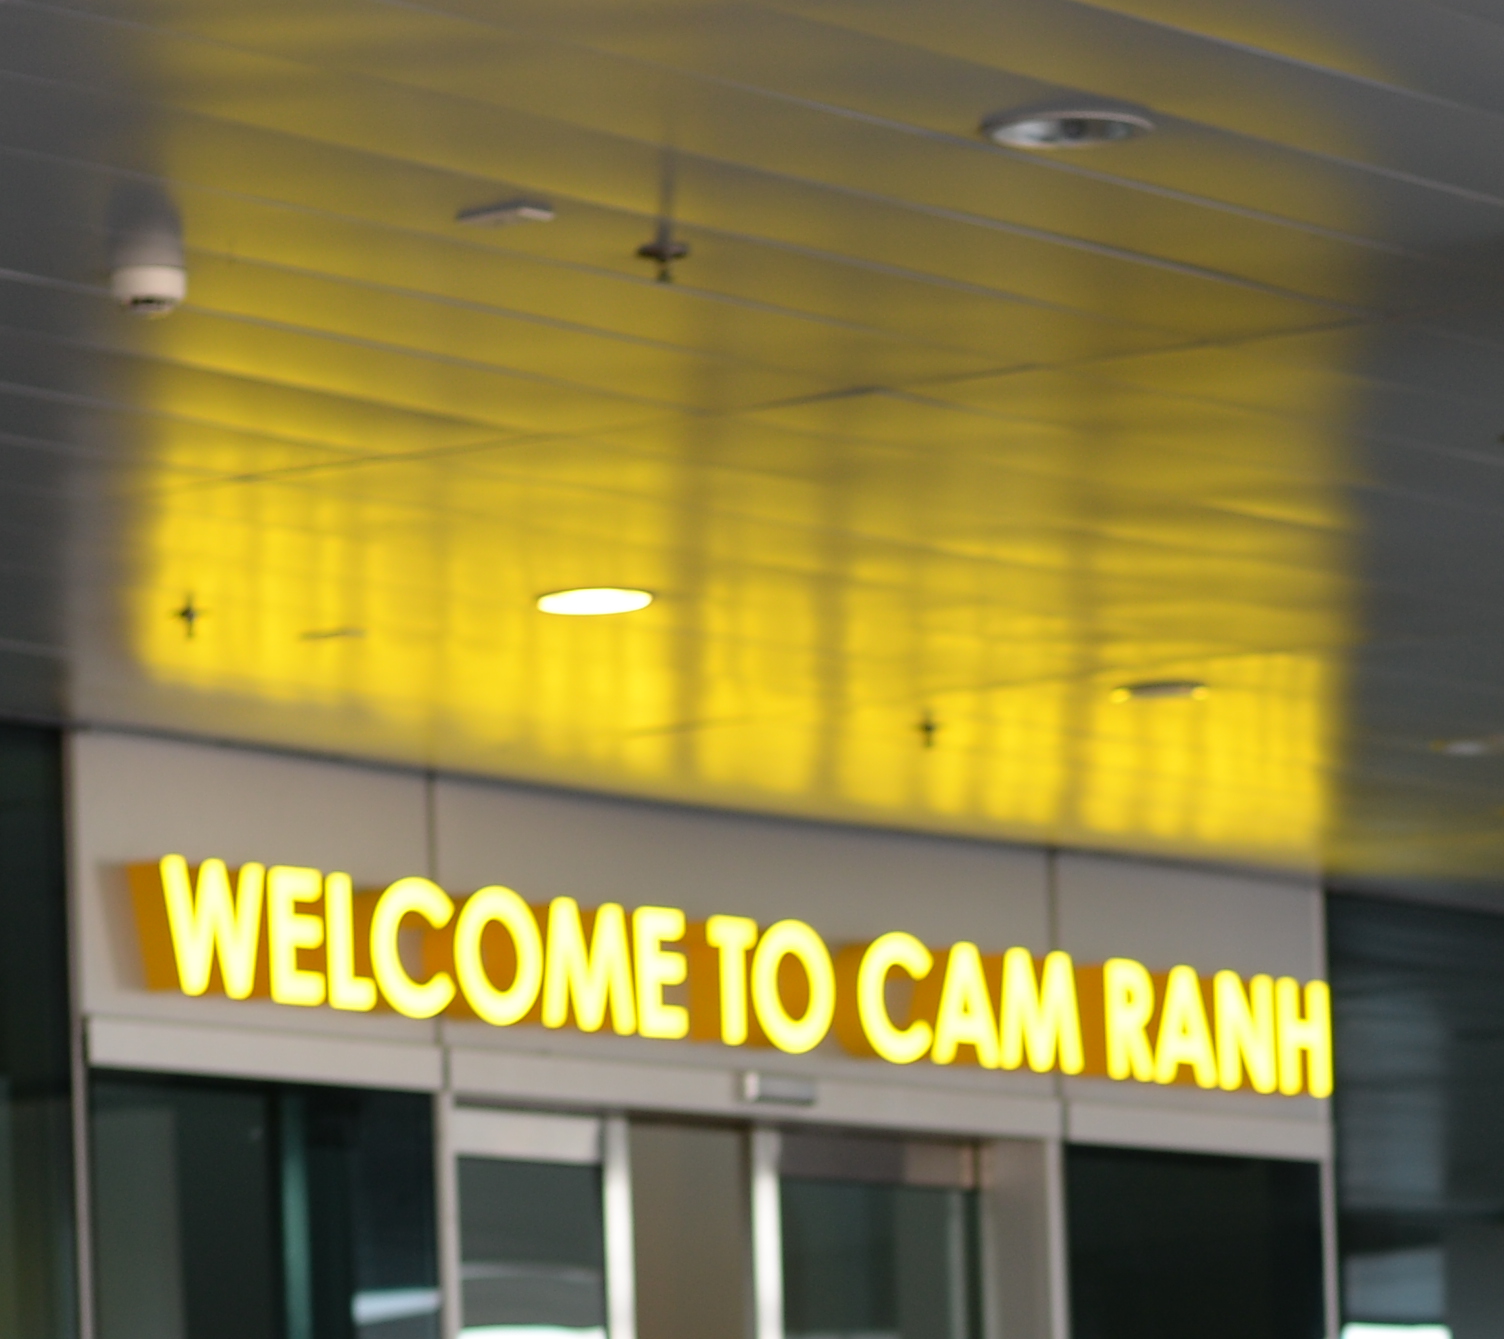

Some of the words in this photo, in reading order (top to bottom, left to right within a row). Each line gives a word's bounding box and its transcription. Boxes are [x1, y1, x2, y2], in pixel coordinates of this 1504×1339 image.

[158, 853, 689, 1040] WELCOME
[705, 914, 836, 1055] TO
[856, 931, 1085, 1075] CAM
[1102, 957, 1333, 1099] RANH
